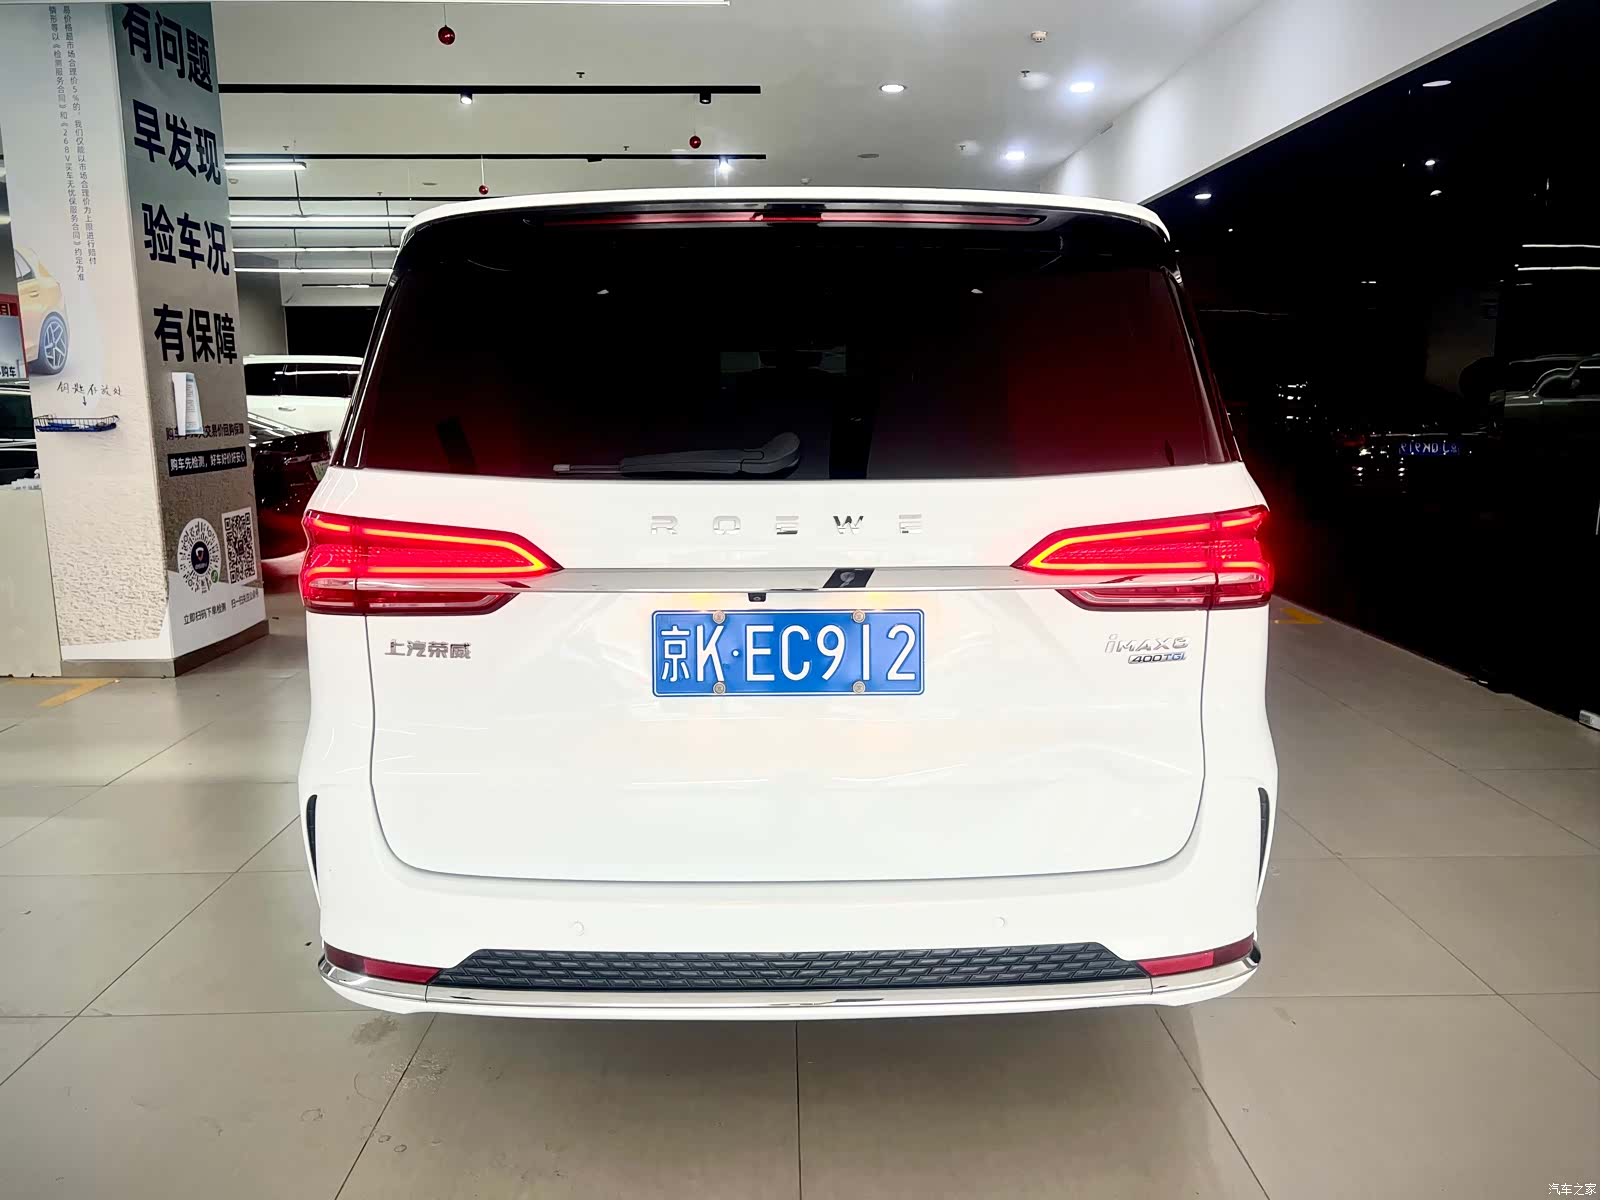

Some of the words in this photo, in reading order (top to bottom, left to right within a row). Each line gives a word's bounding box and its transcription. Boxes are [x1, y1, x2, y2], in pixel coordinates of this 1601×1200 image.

[122, 3, 213, 93] 有问题
[132, 99, 222, 186] 早发现
[141, 203, 230, 277] 验车况
[154, 303, 238, 365] 有保障
[0, 365, 17, 378] 购车
[650, 513, 923, 536] ROEWE
[384, 639, 472, 659] 上汽荣威
[1131, 652, 1186, 664] 400TGI
